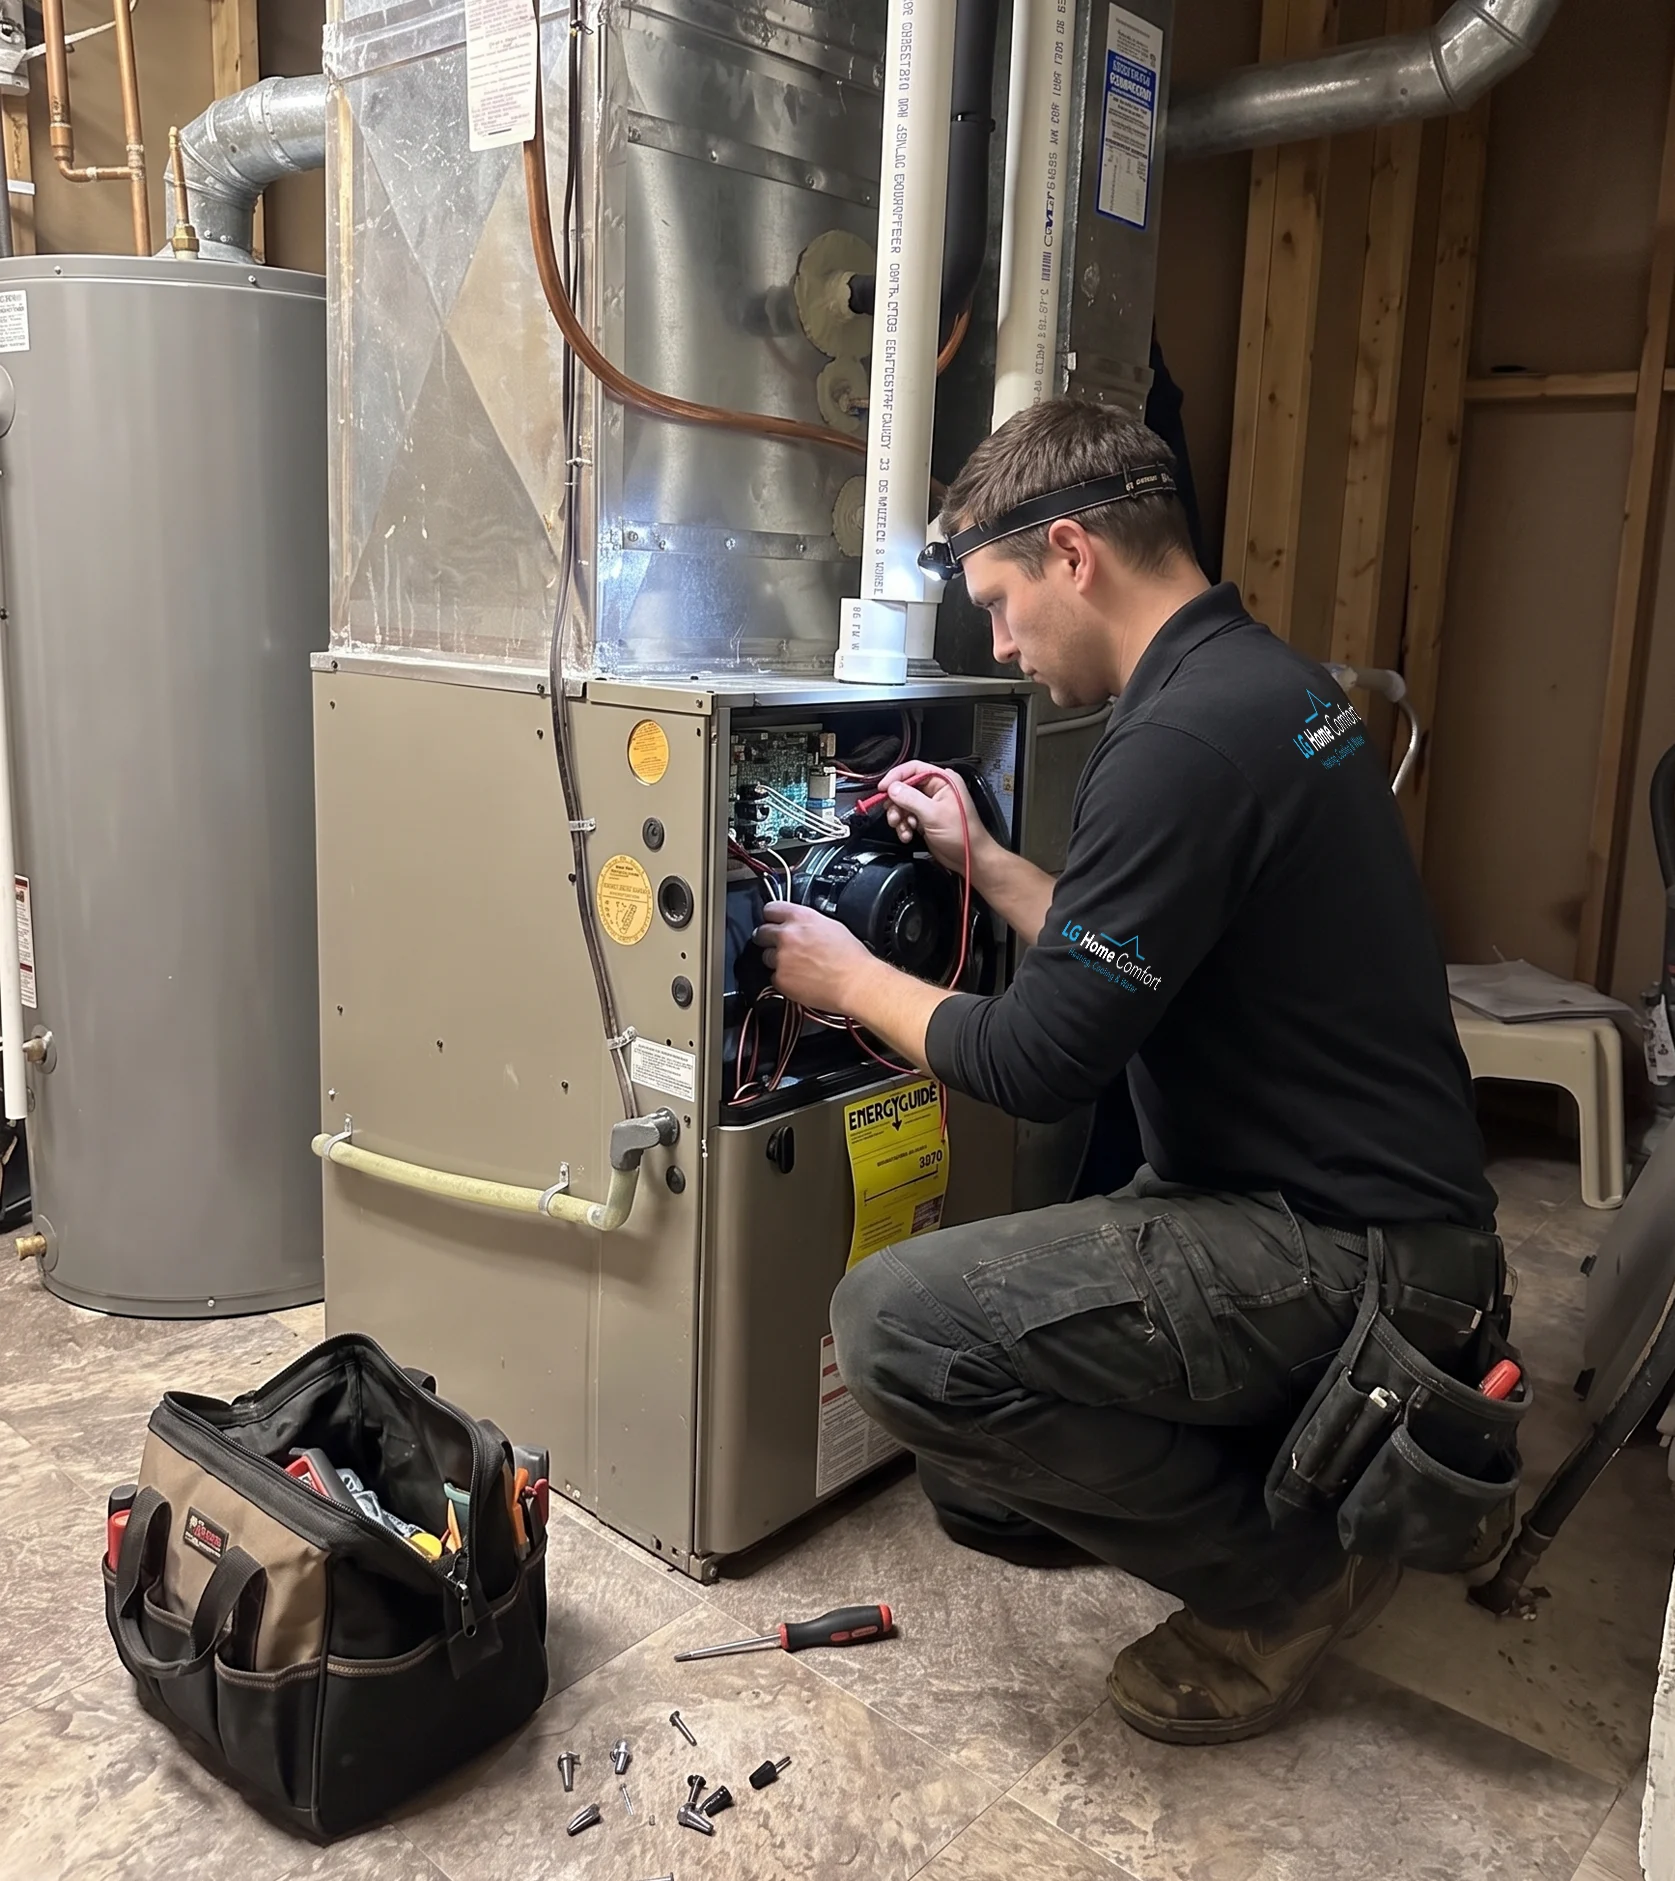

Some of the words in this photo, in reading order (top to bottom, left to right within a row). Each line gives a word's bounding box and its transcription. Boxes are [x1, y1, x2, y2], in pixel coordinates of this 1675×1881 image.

[1324, 702, 1362, 736] Comfort
[1292, 734, 1315, 759] LG
[1303, 728, 1335, 752] Home
[1062, 920, 1083, 942] LG
[1080, 931, 1115, 962] Home
[1116, 953, 1162, 991] Comfort
[1092, 961, 1115, 982] Cooling
[849, 1084, 938, 1131] ENERGYGUIDE
